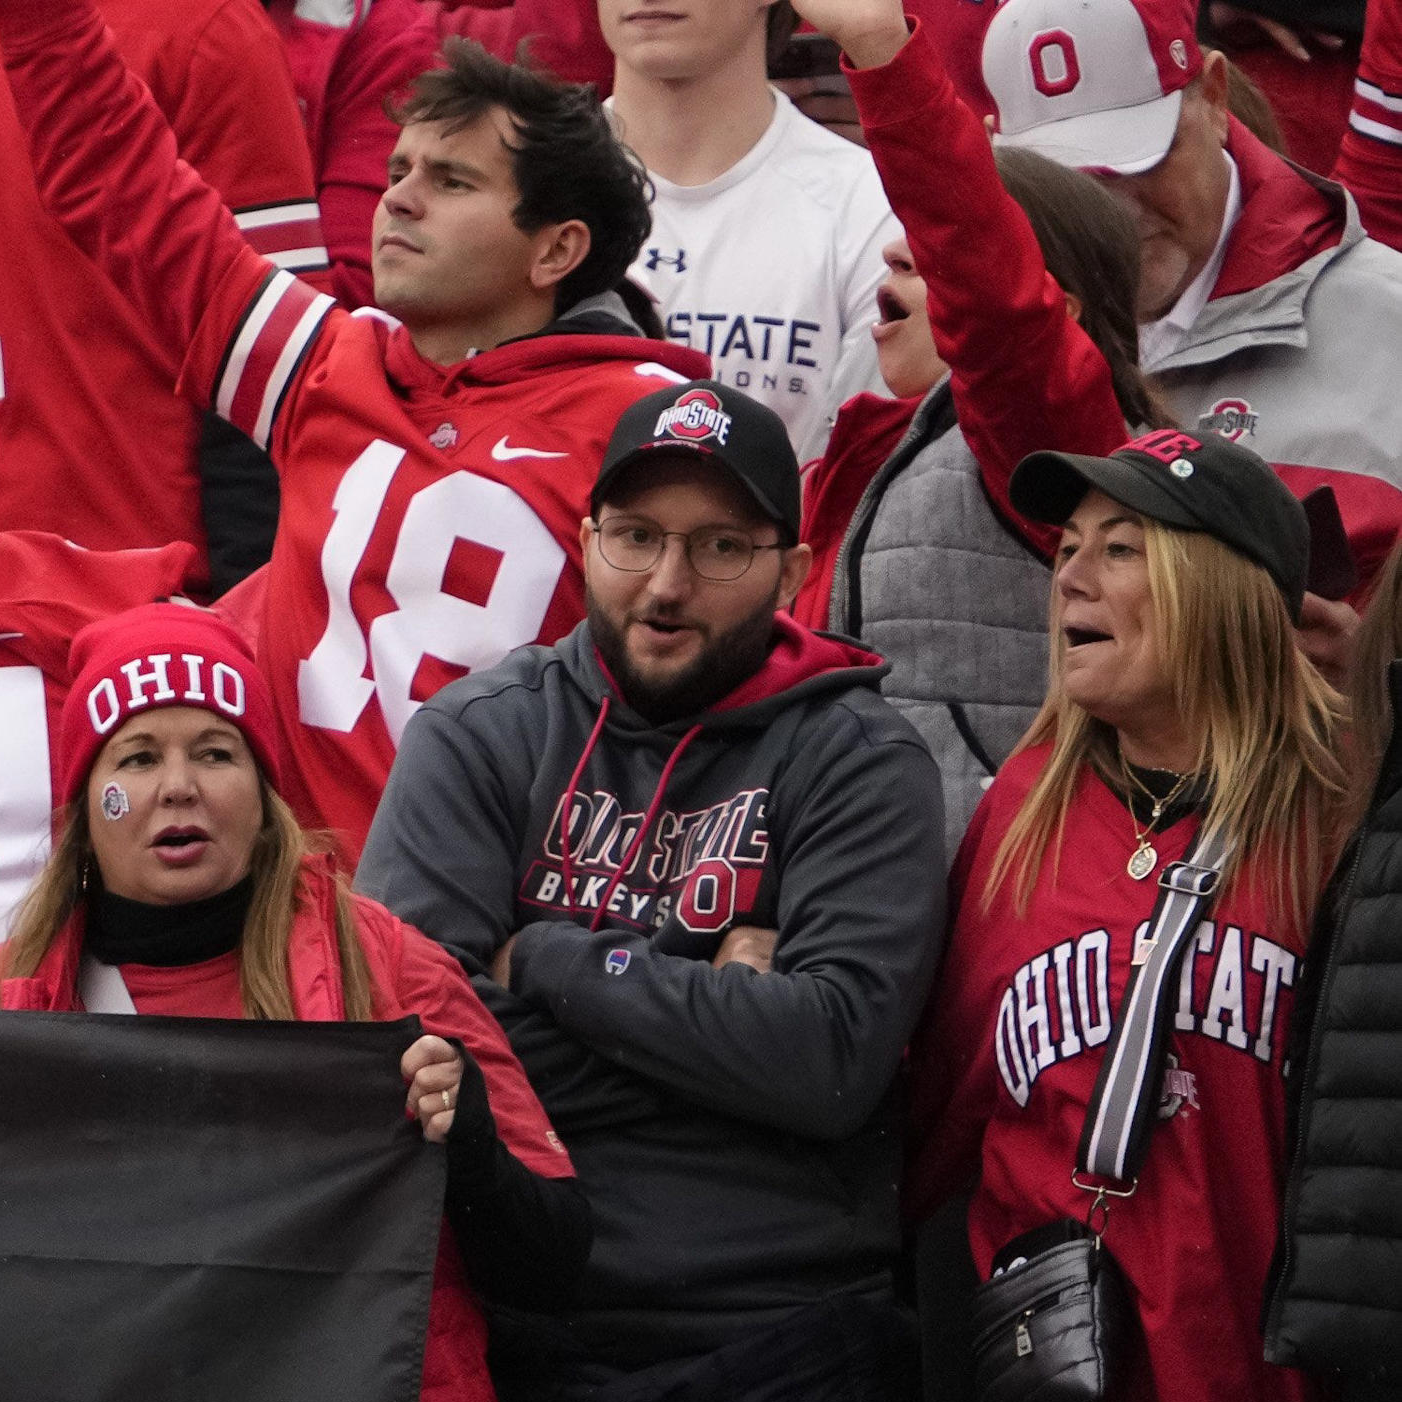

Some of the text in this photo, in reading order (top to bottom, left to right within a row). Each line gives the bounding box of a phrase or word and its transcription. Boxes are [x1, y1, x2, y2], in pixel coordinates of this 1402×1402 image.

[1028, 27, 1081, 98] O
[667, 312, 822, 369] STATE
[688, 401, 733, 446] STATE
[297, 438, 568, 757] 18
[87, 653, 246, 734] OHIO
[995, 928, 1113, 1109] OHIO
